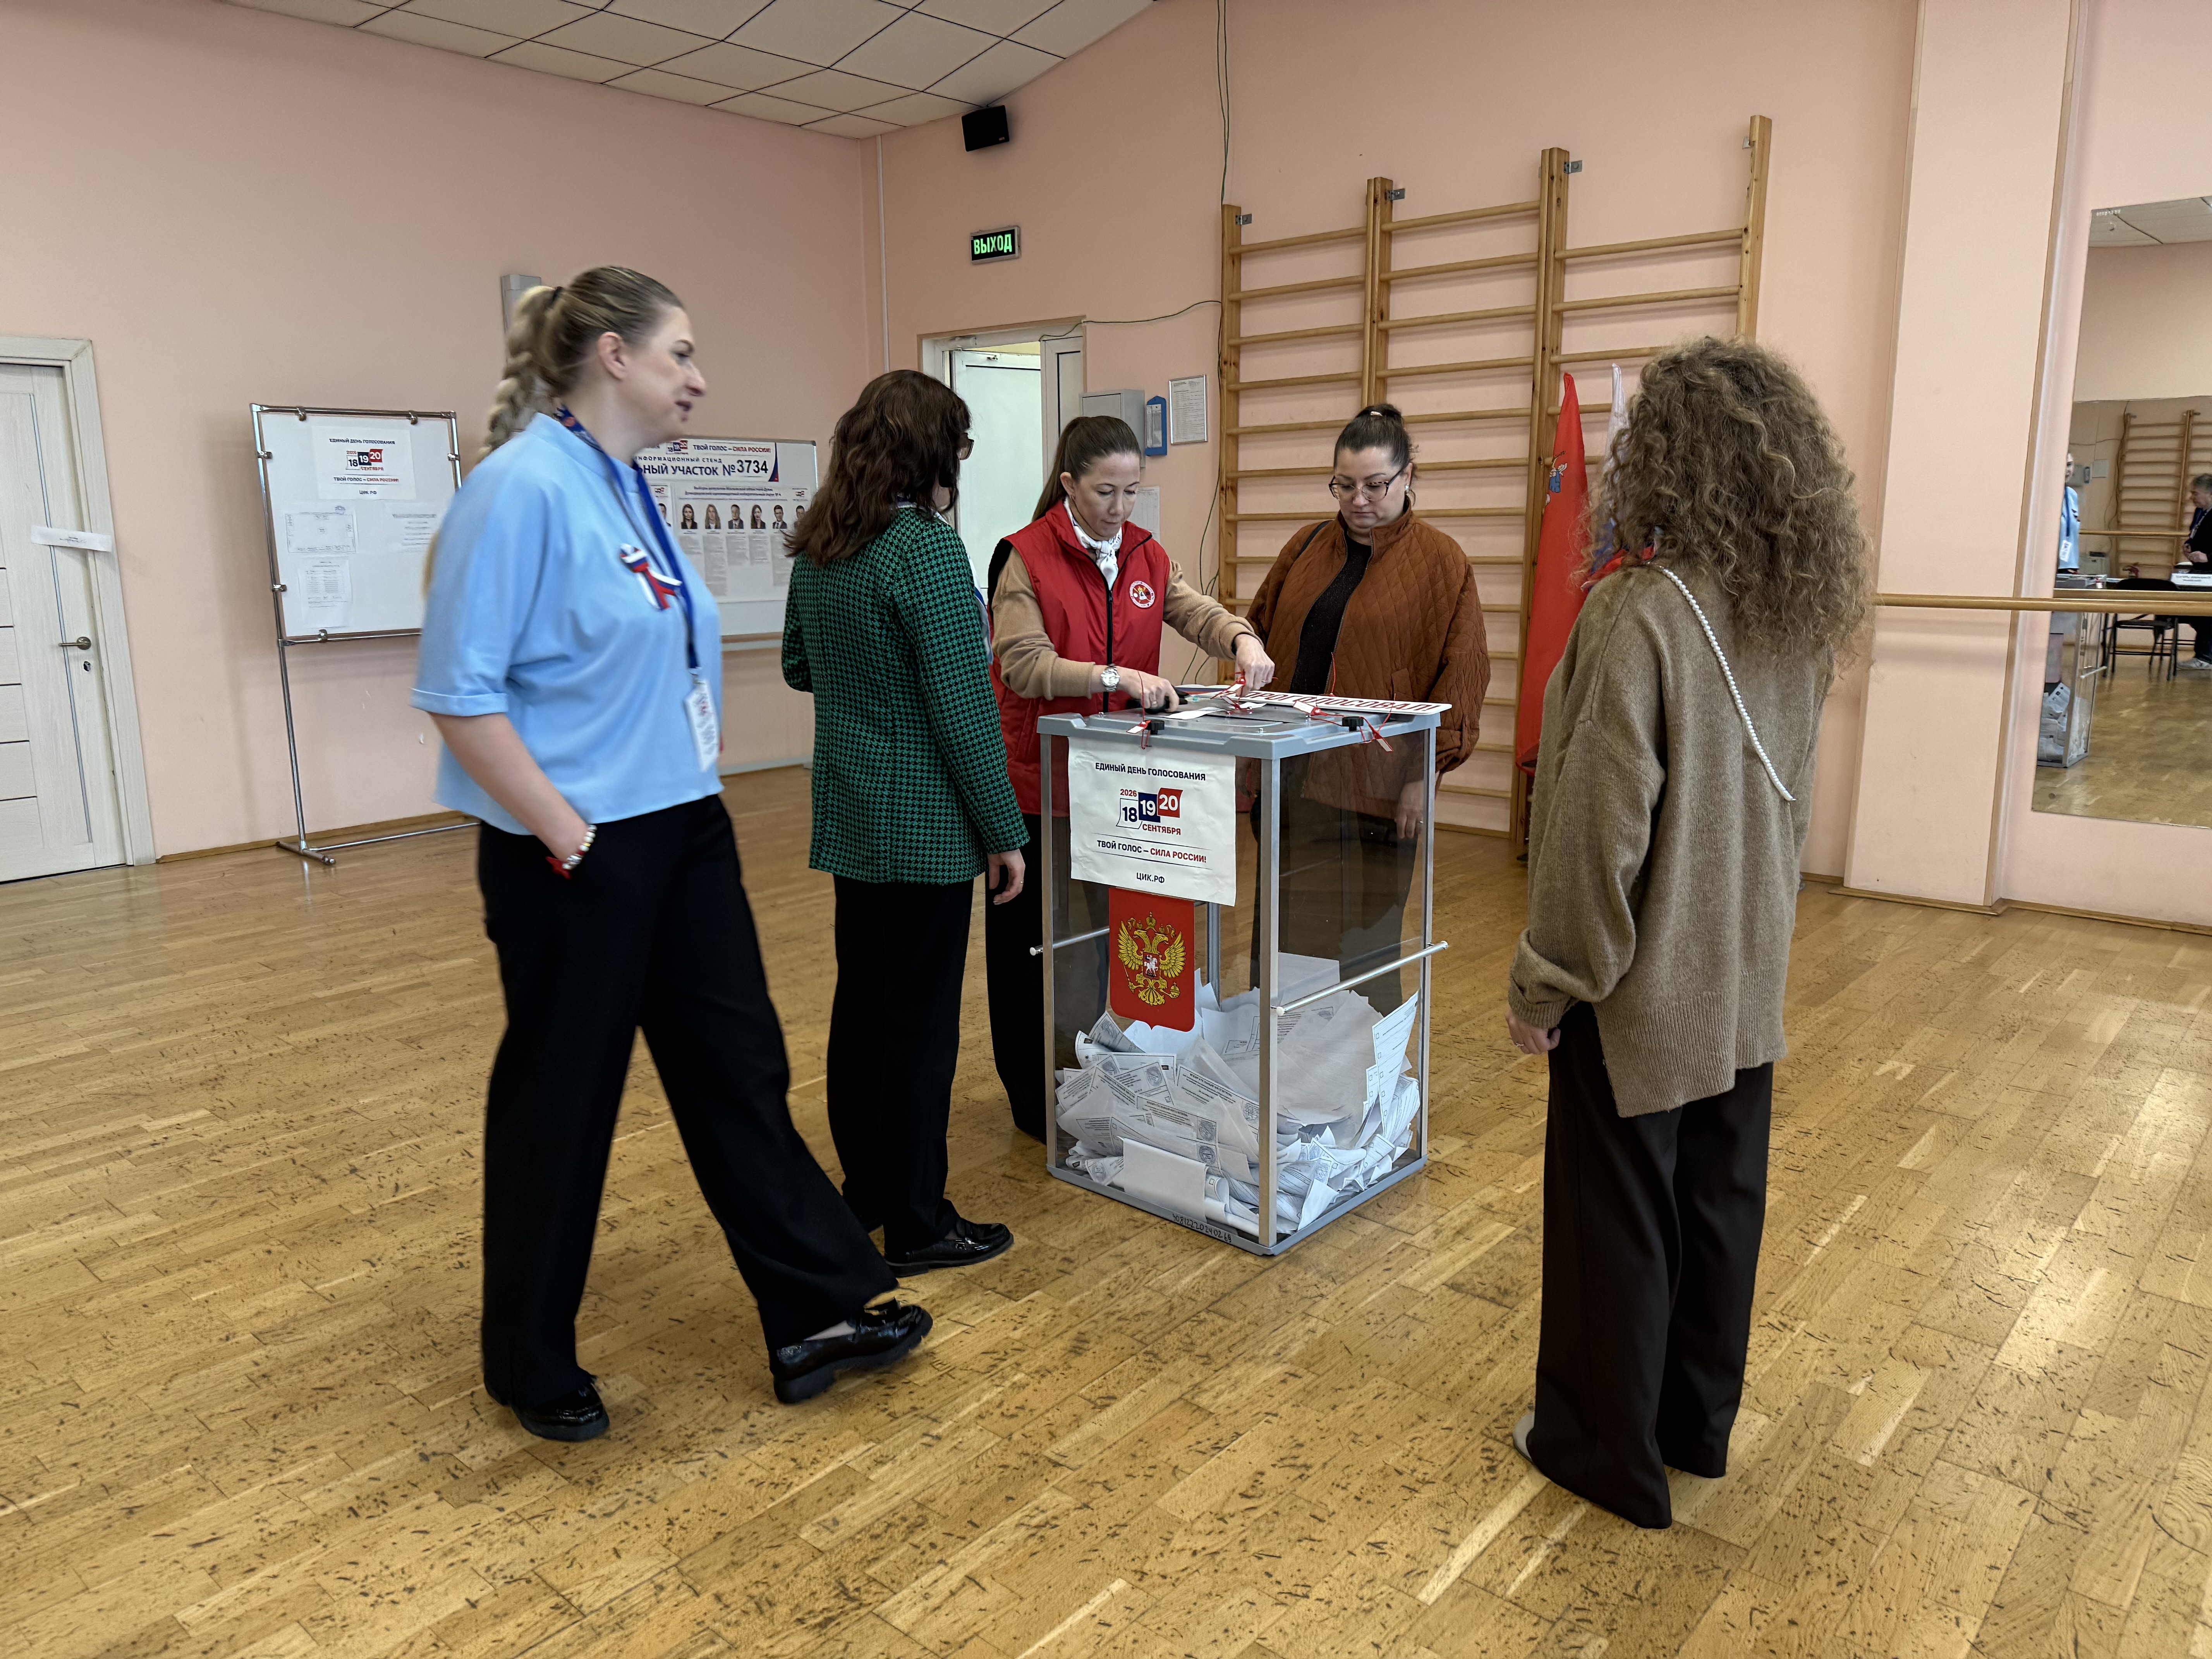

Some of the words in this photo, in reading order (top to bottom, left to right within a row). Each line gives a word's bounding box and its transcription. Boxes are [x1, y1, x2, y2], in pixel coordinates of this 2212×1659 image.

[974, 234, 1012, 254] ВЫХОД
[359, 455, 369, 463] 19
[370, 452, 381, 460] 20
[671, 465, 719, 476] УЧАСТОК
[1095, 762, 1125, 772] ЕДИНЫЙ
[1127, 766, 1146, 775] ДЕНЬ
[1148, 768, 1206, 781] ГОЛОСОВАНИЯ
[1120, 789, 1137, 797] 2026
[1122, 806, 1137, 823] 18
[1140, 800, 1156, 816] 19
[1159, 794, 1178, 811] 20
[1142, 824, 1181, 835] СЕНТЯБРЯ
[1097, 840, 1116, 849] ТВОЙ
[1118, 843, 1142, 853] ГОЛОС
[1150, 848, 1171, 858] СИЛА
[1172, 851, 1207, 863] РОССИИ!
[1136, 872, 1165, 883] ЦИК.РФ
